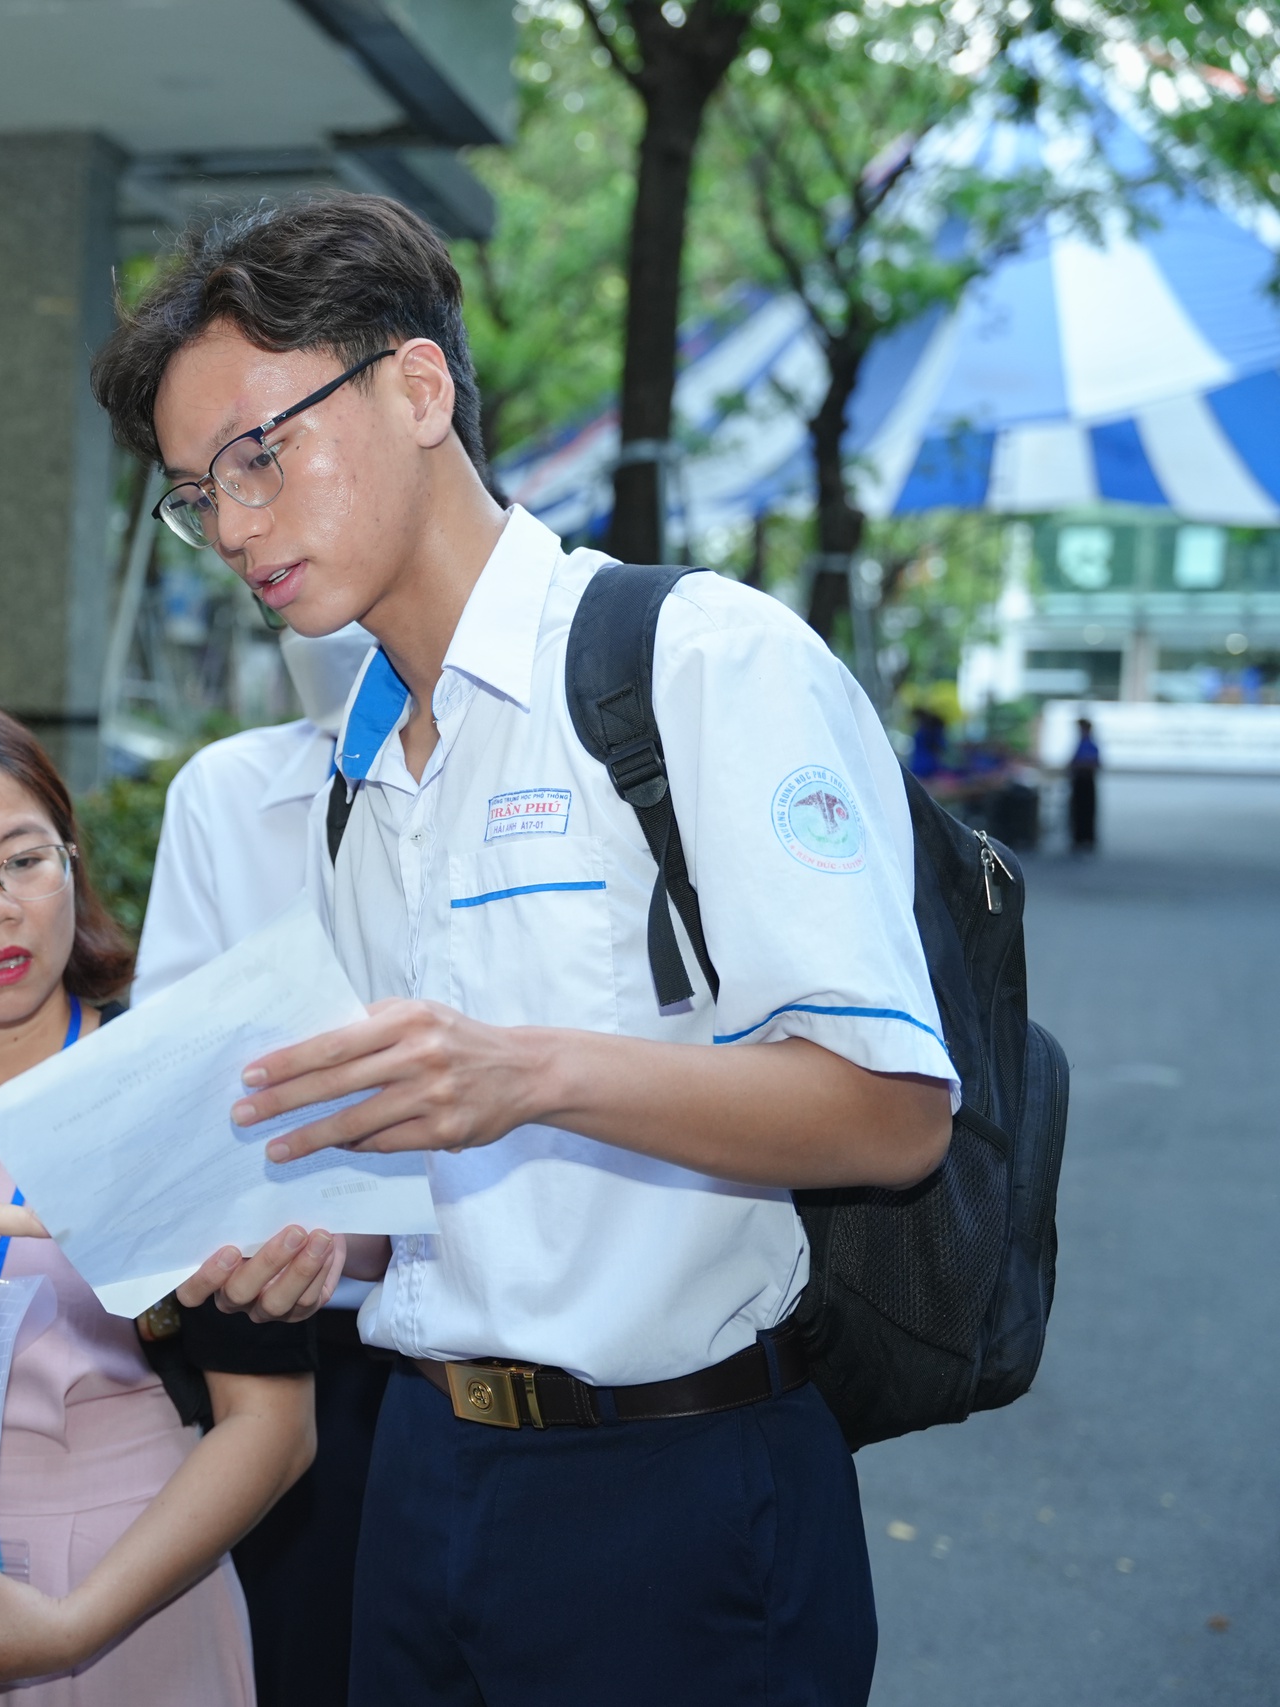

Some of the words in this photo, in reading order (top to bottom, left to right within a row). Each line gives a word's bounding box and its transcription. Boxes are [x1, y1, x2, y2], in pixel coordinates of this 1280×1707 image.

[490, 803, 521, 819] TRẦN
[525, 801, 561, 813] PHÚ
[520, 821, 544, 830] A17-01
